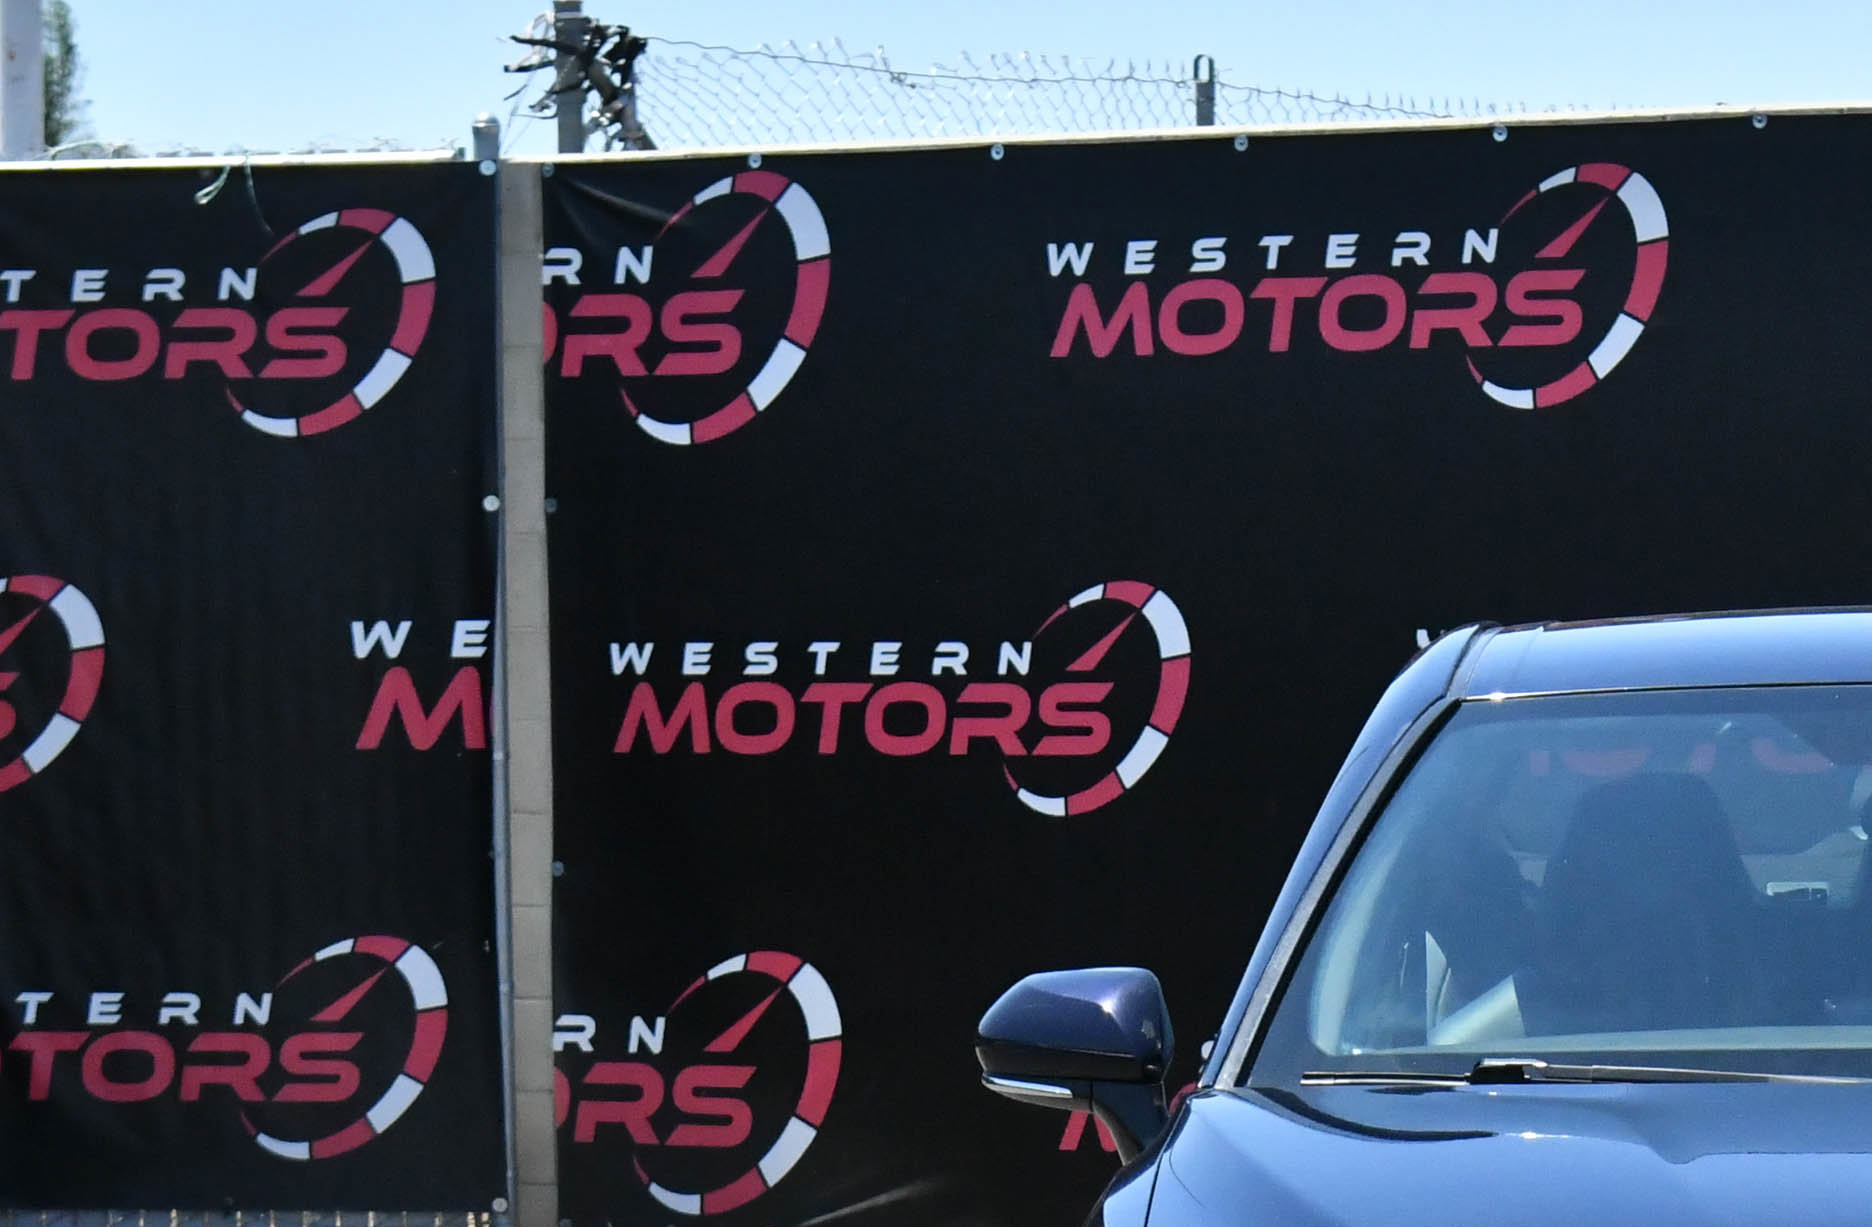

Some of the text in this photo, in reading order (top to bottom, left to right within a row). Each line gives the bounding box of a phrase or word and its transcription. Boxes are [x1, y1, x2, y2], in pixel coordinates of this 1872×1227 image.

[0, 268, 256, 302] TERN
[1047, 229, 1498, 276] WESTERN
[0, 307, 348, 380] TORS
[543, 290, 743, 377] RS
[1051, 269, 1584, 358] MOTORS
[352, 620, 490, 659] WE
[611, 642, 1032, 675] WESTERN
[356, 666, 486, 750] M
[615, 682, 1114, 756] MOTORS
[16, 992, 272, 1025] TERN
[11, 1032, 363, 1102] TORS
[554, 1062, 755, 1147] RS
